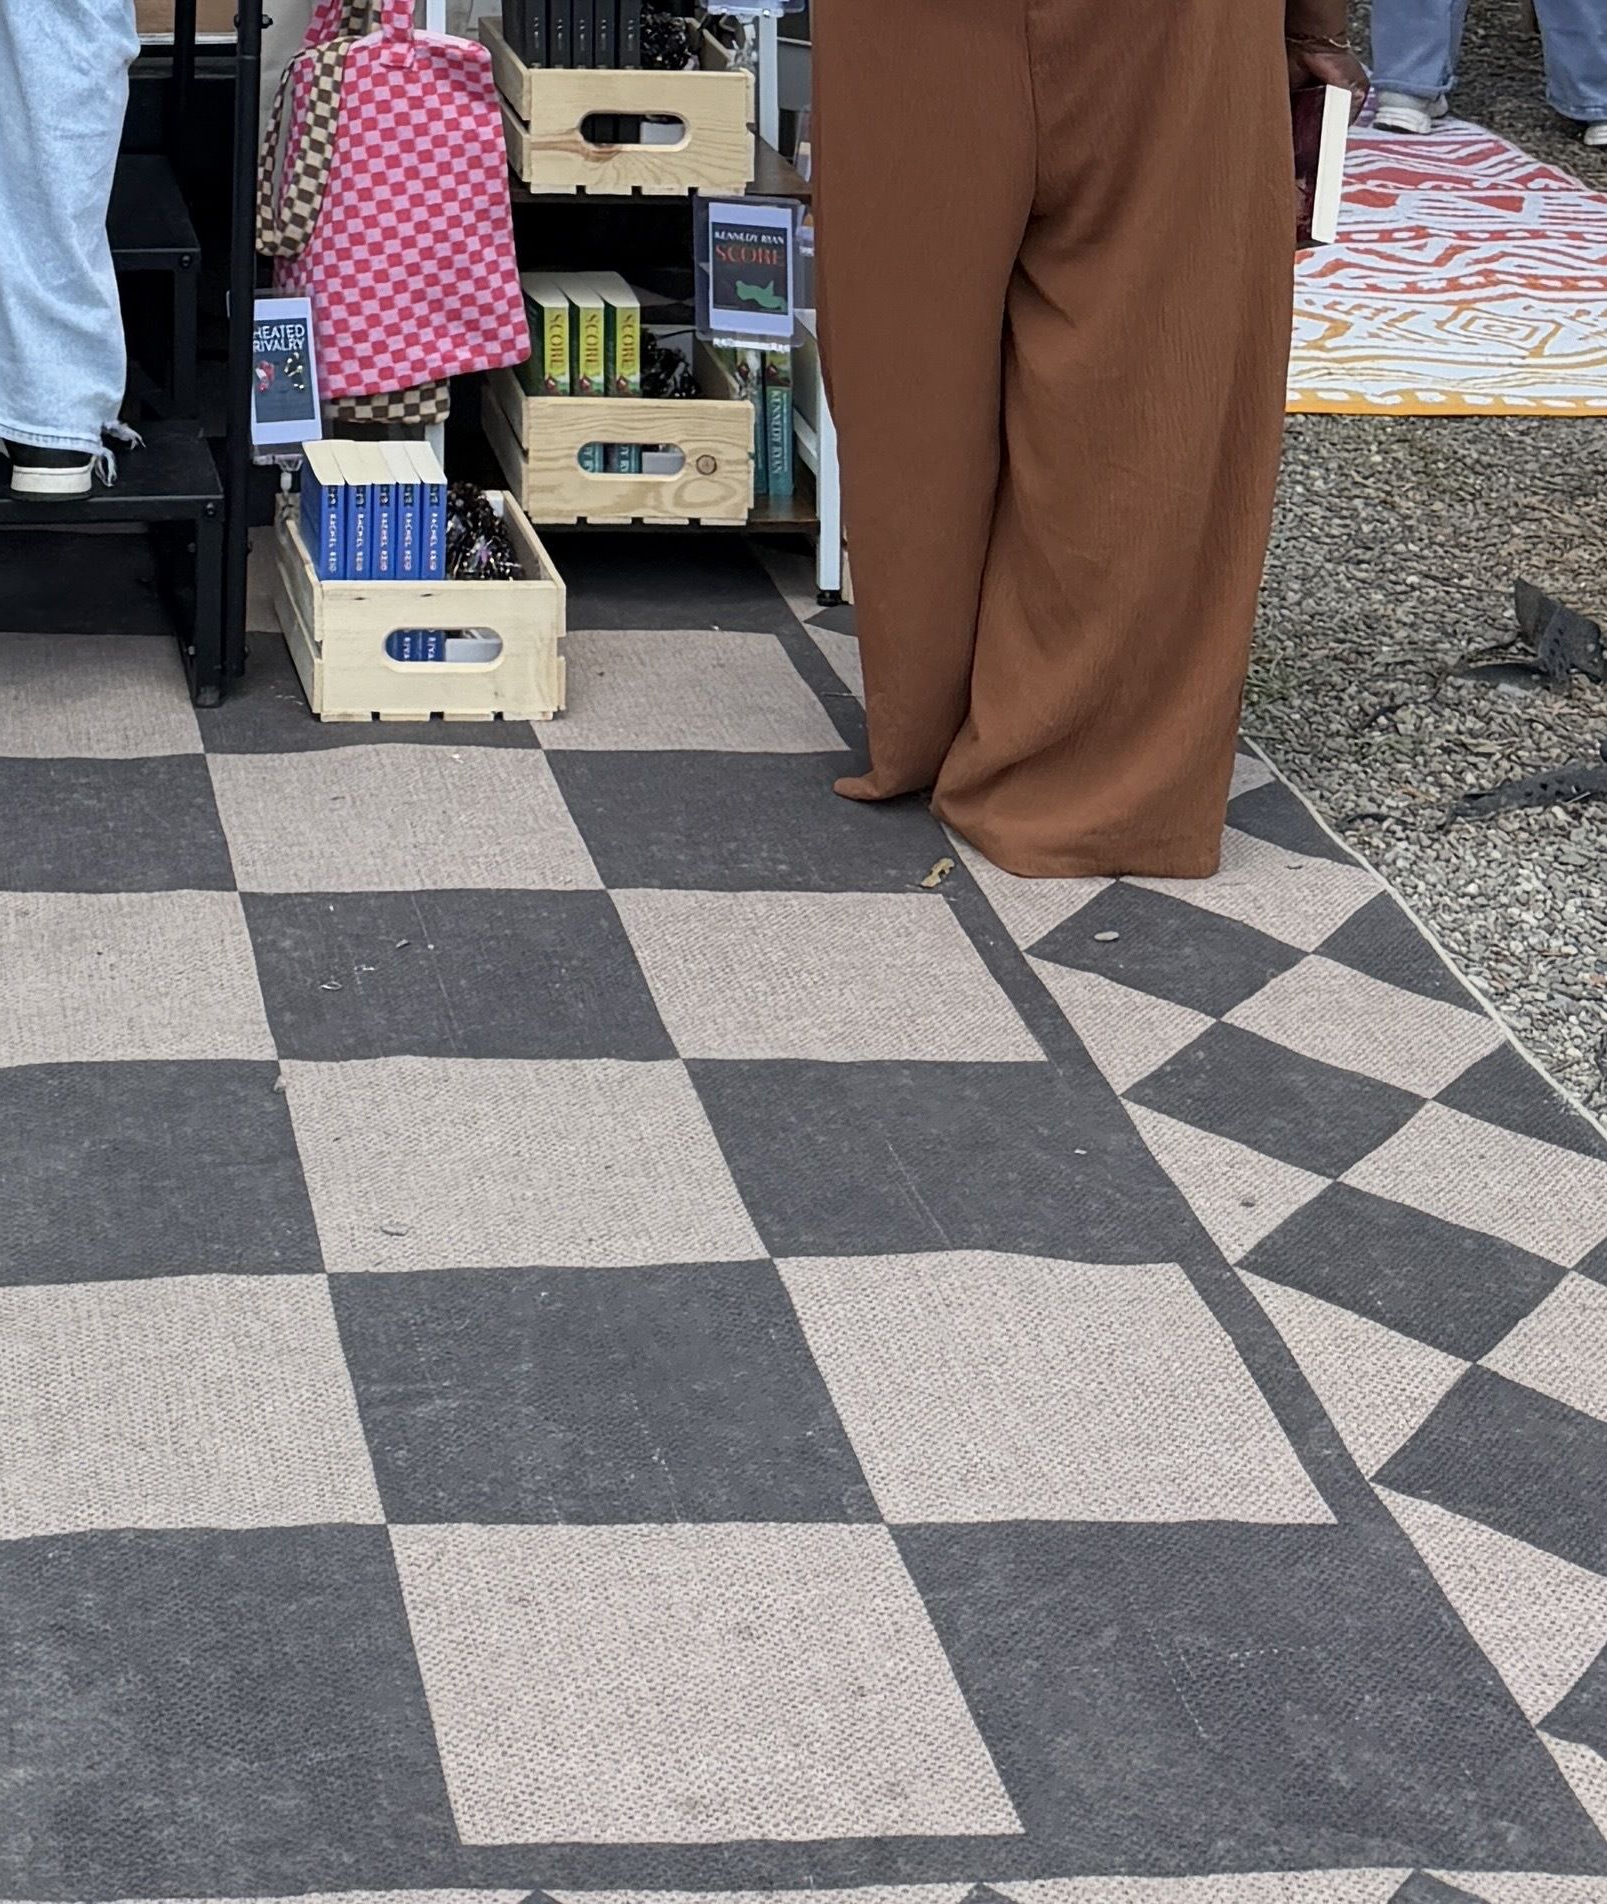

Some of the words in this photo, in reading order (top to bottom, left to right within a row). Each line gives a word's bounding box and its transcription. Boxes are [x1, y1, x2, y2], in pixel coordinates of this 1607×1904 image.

[761, 234, 785, 244] RYAN
[715, 245, 784, 265] SCORE
[253, 338, 305, 352] RIVALRY
[254, 324, 305, 339] HEATED
[550, 313, 564, 370] SCORE
[585, 313, 600, 370] SCORE
[621, 313, 635, 370] SCORE
[771, 390, 782, 444] KENNEDY
[772, 446, 783, 475] RYAN
